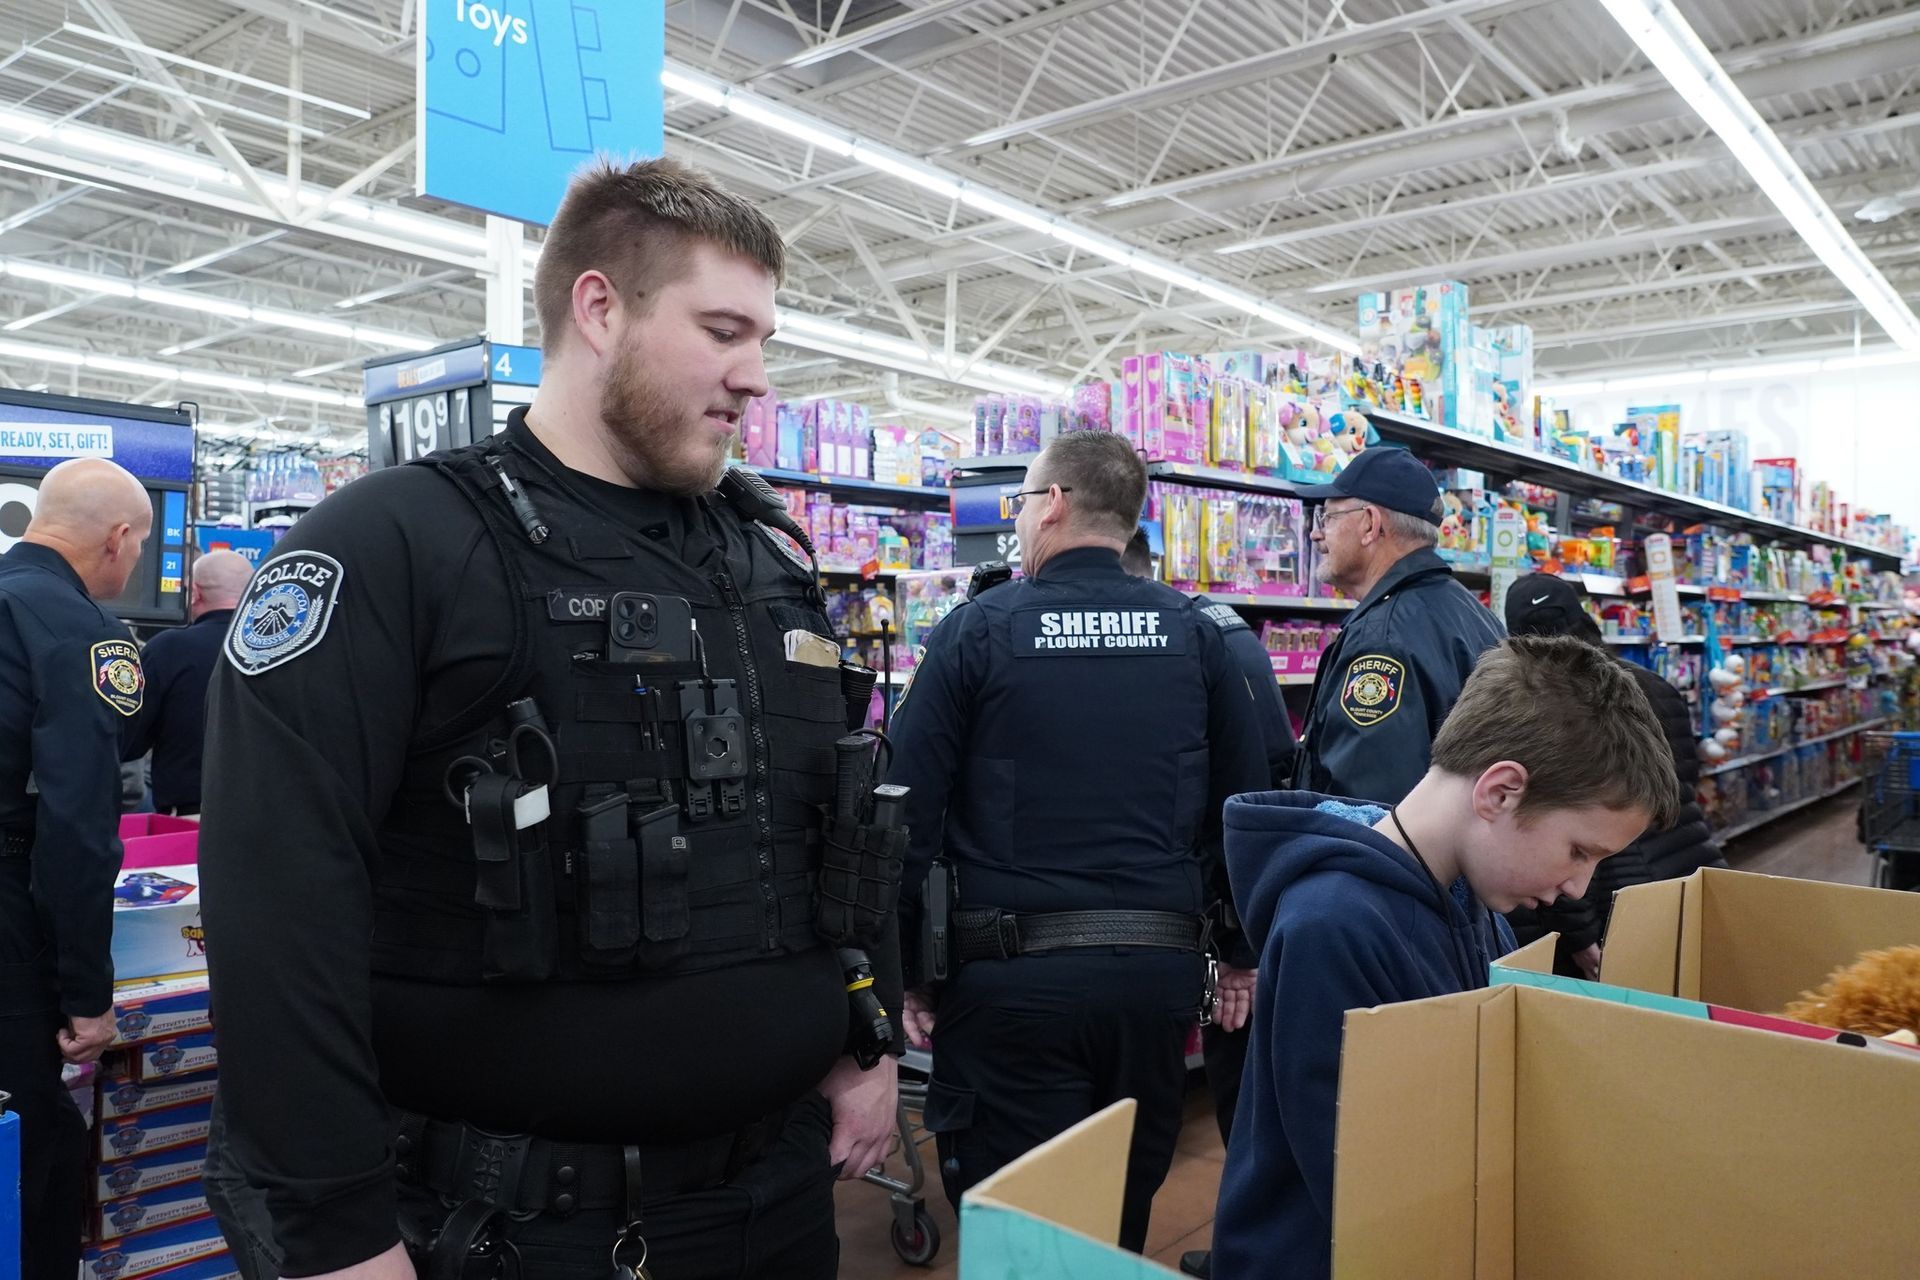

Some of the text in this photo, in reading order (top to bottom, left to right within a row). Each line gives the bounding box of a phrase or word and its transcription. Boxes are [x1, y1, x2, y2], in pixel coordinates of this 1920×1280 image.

[494, 352, 513, 377] 4
[1, 430, 108, 452] READY, SET, GIFT!
[166, 527, 181, 537] BK
[165, 561, 176, 570] 21
[255, 562, 334, 593] POLICE
[271, 584, 286, 596] OF
[286, 586, 308, 614] ALCOA
[568, 597, 609, 617] COP
[1040, 611, 1160, 636] SHERIFF
[1104, 634, 1168, 648] COUNTY
[97, 646, 139, 662] SHERIF
[1352, 660, 1398, 675] SHERIFF
